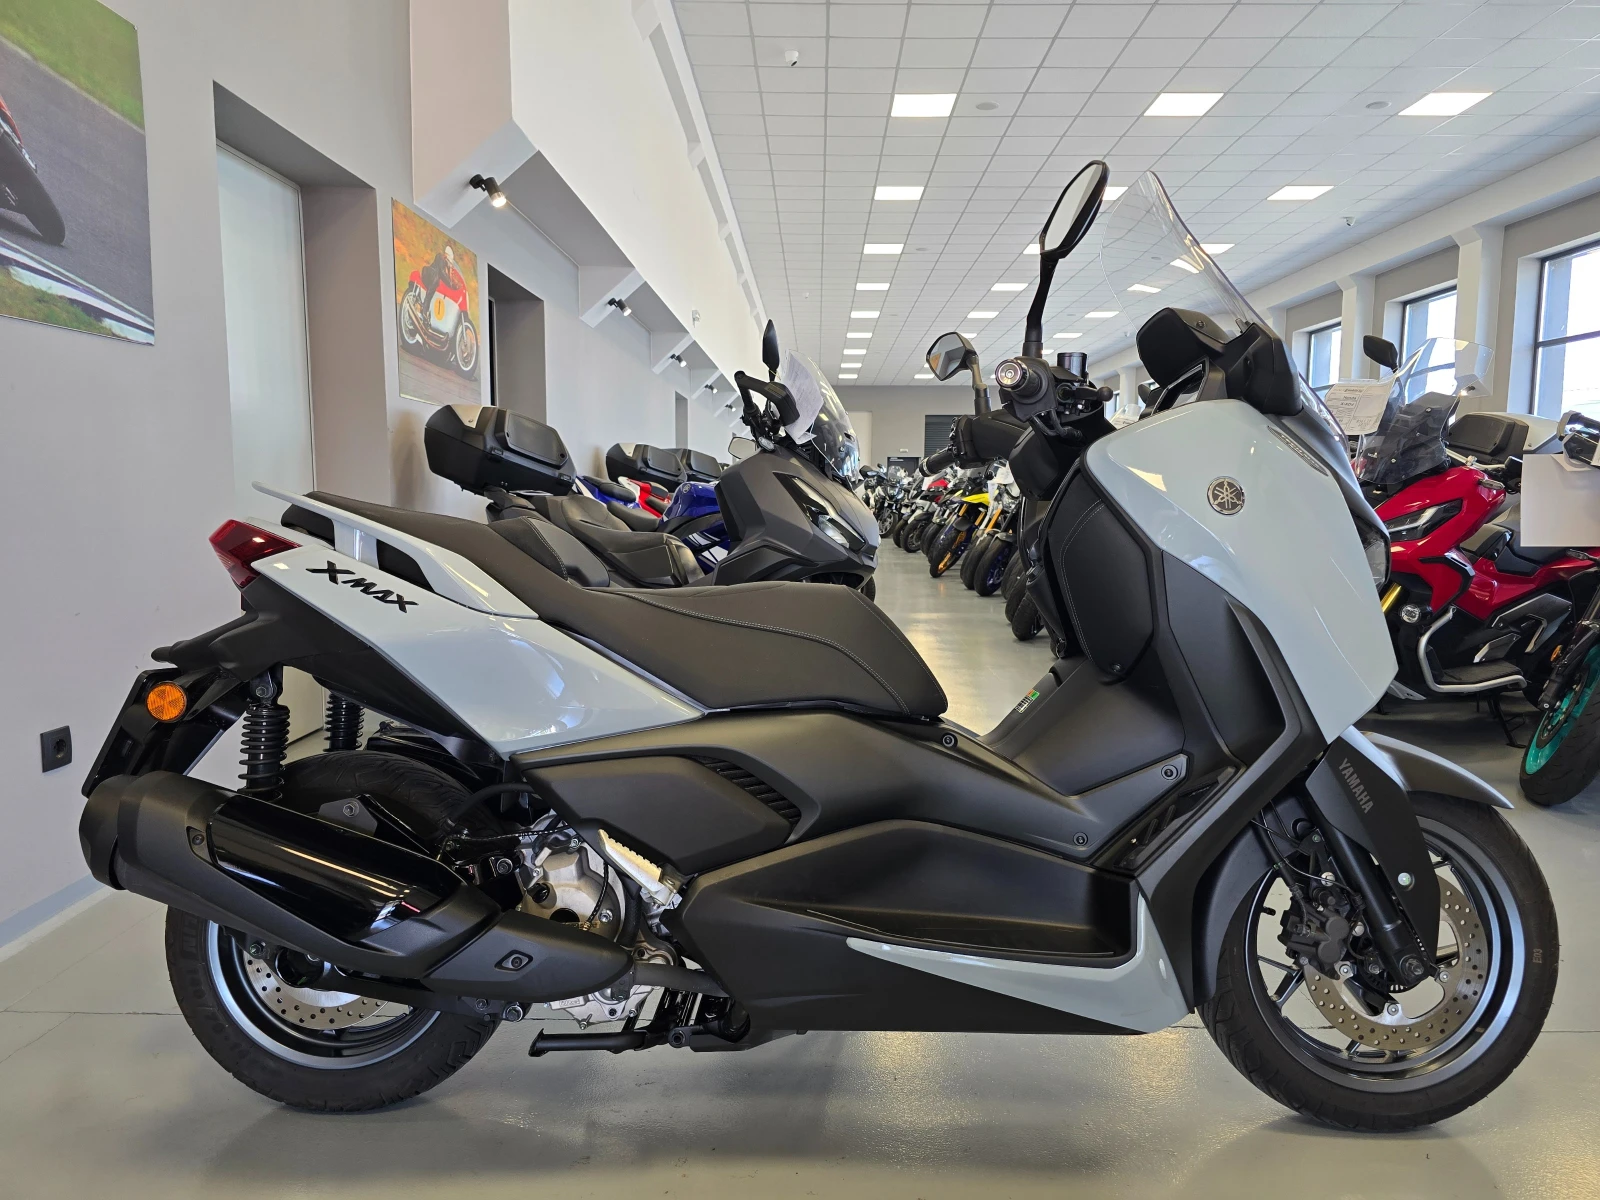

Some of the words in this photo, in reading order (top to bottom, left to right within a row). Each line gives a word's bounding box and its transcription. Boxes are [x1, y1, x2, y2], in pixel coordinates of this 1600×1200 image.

[305, 560, 419, 614] XMAX
[1338, 757, 1374, 814] YAMAHA
[1532, 948, 1543, 964] E03
